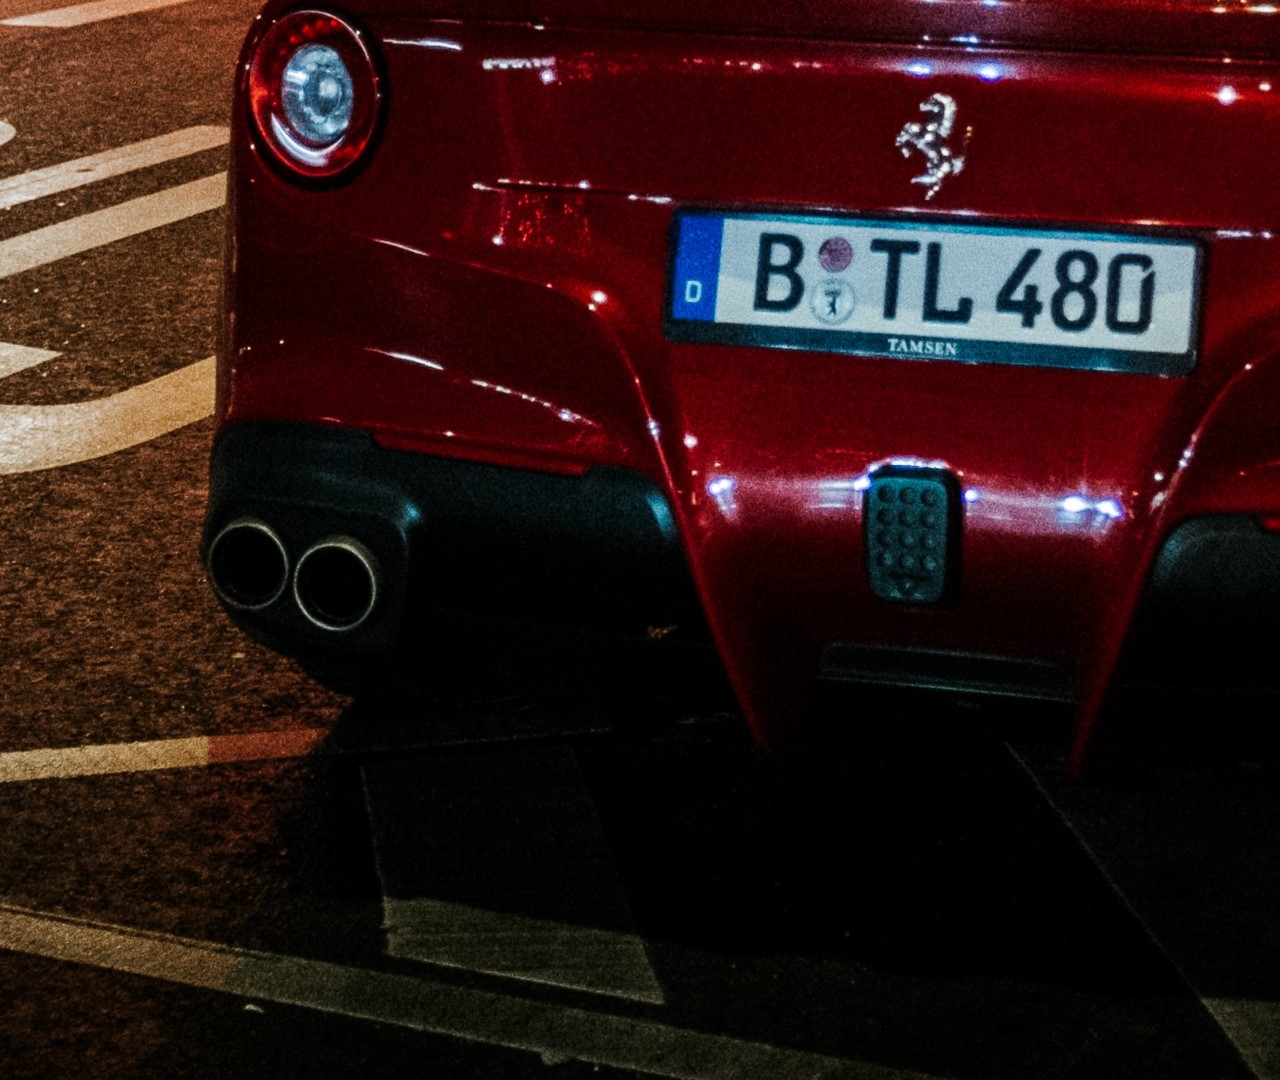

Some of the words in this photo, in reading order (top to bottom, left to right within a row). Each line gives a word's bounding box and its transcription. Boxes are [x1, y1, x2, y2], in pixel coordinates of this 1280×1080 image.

[685, 281, 702, 302] D
[754, 232, 805, 312] B
[870, 238, 974, 324] TL
[996, 248, 1157, 335] 480
[887, 337, 958, 357] TAMSEN
